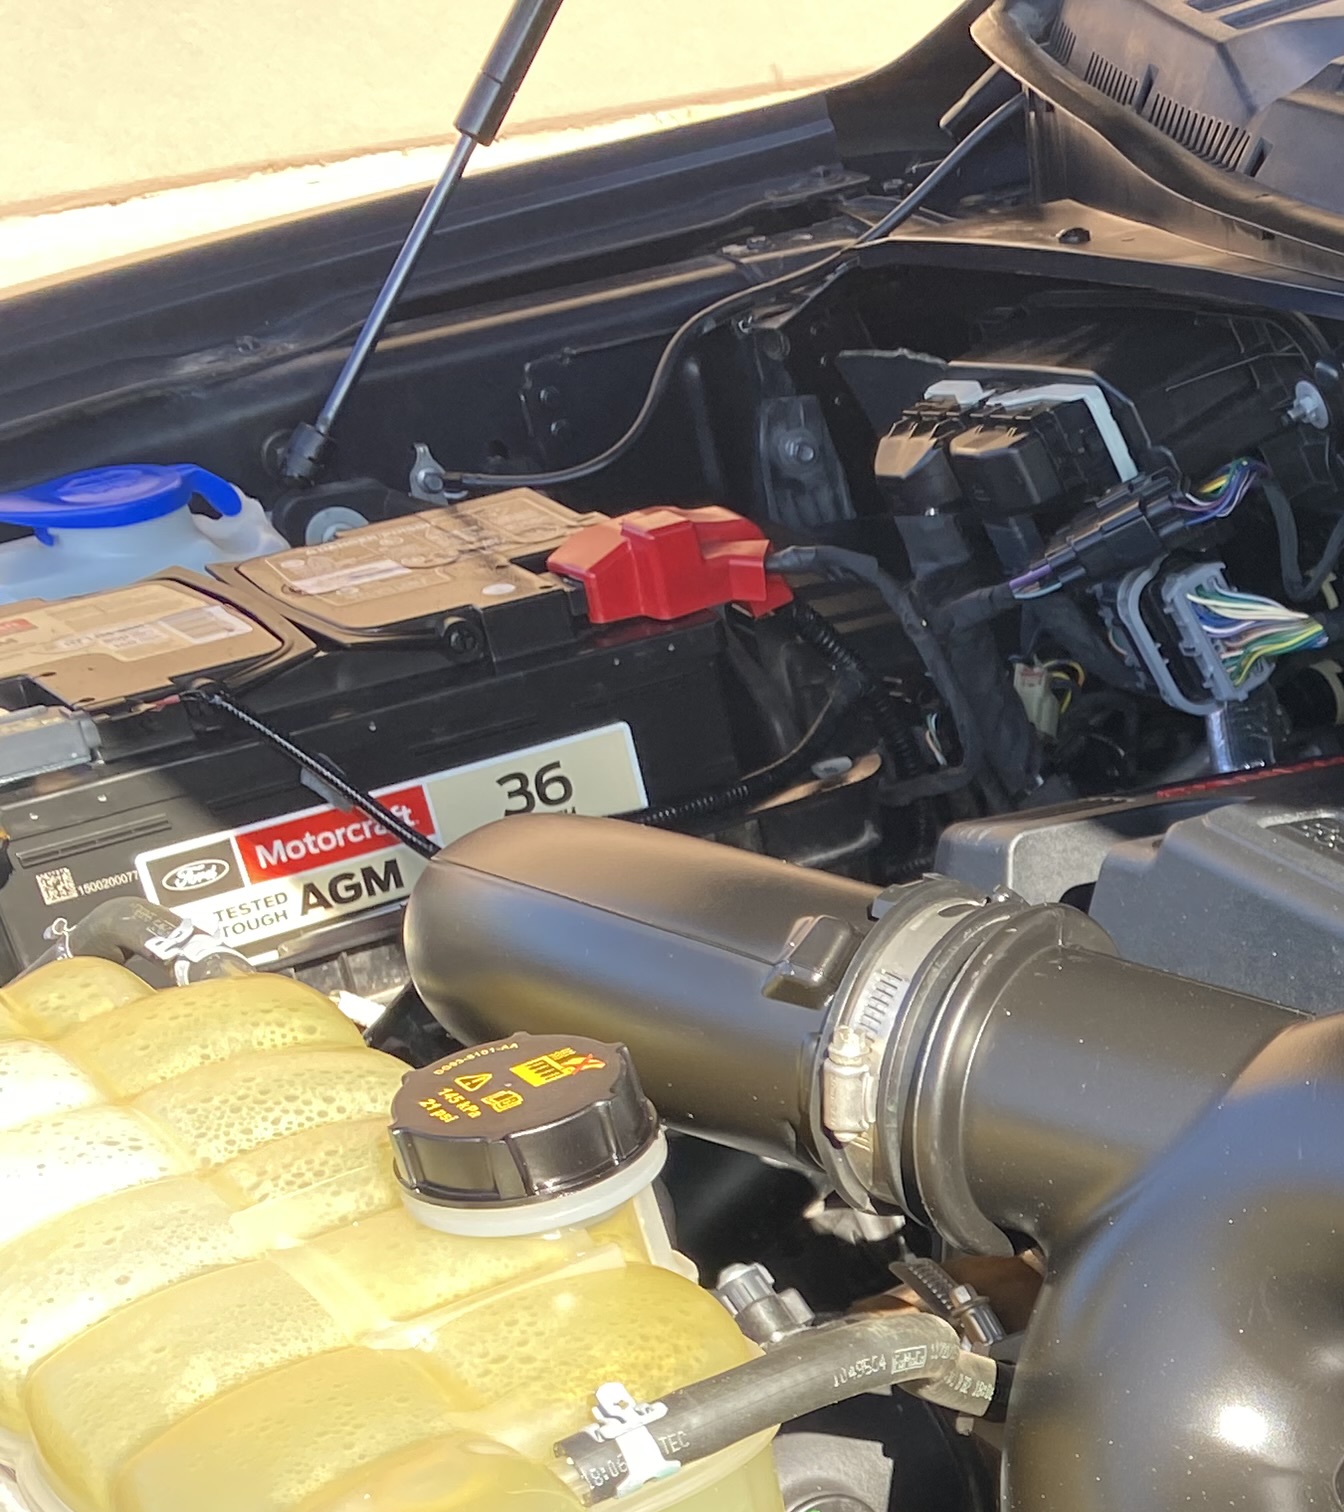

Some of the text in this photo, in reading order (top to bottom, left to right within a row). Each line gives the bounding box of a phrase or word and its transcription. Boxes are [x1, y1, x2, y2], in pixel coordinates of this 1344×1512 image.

[495, 760, 573, 817] 36
[300, 859, 405, 917] AGM
[213, 892, 288, 921] TESTED
[222, 910, 288, 938] TOUGH
[418, 1098, 460, 1123] 21 psi
[438, 1088, 482, 1119] 145 kPa
